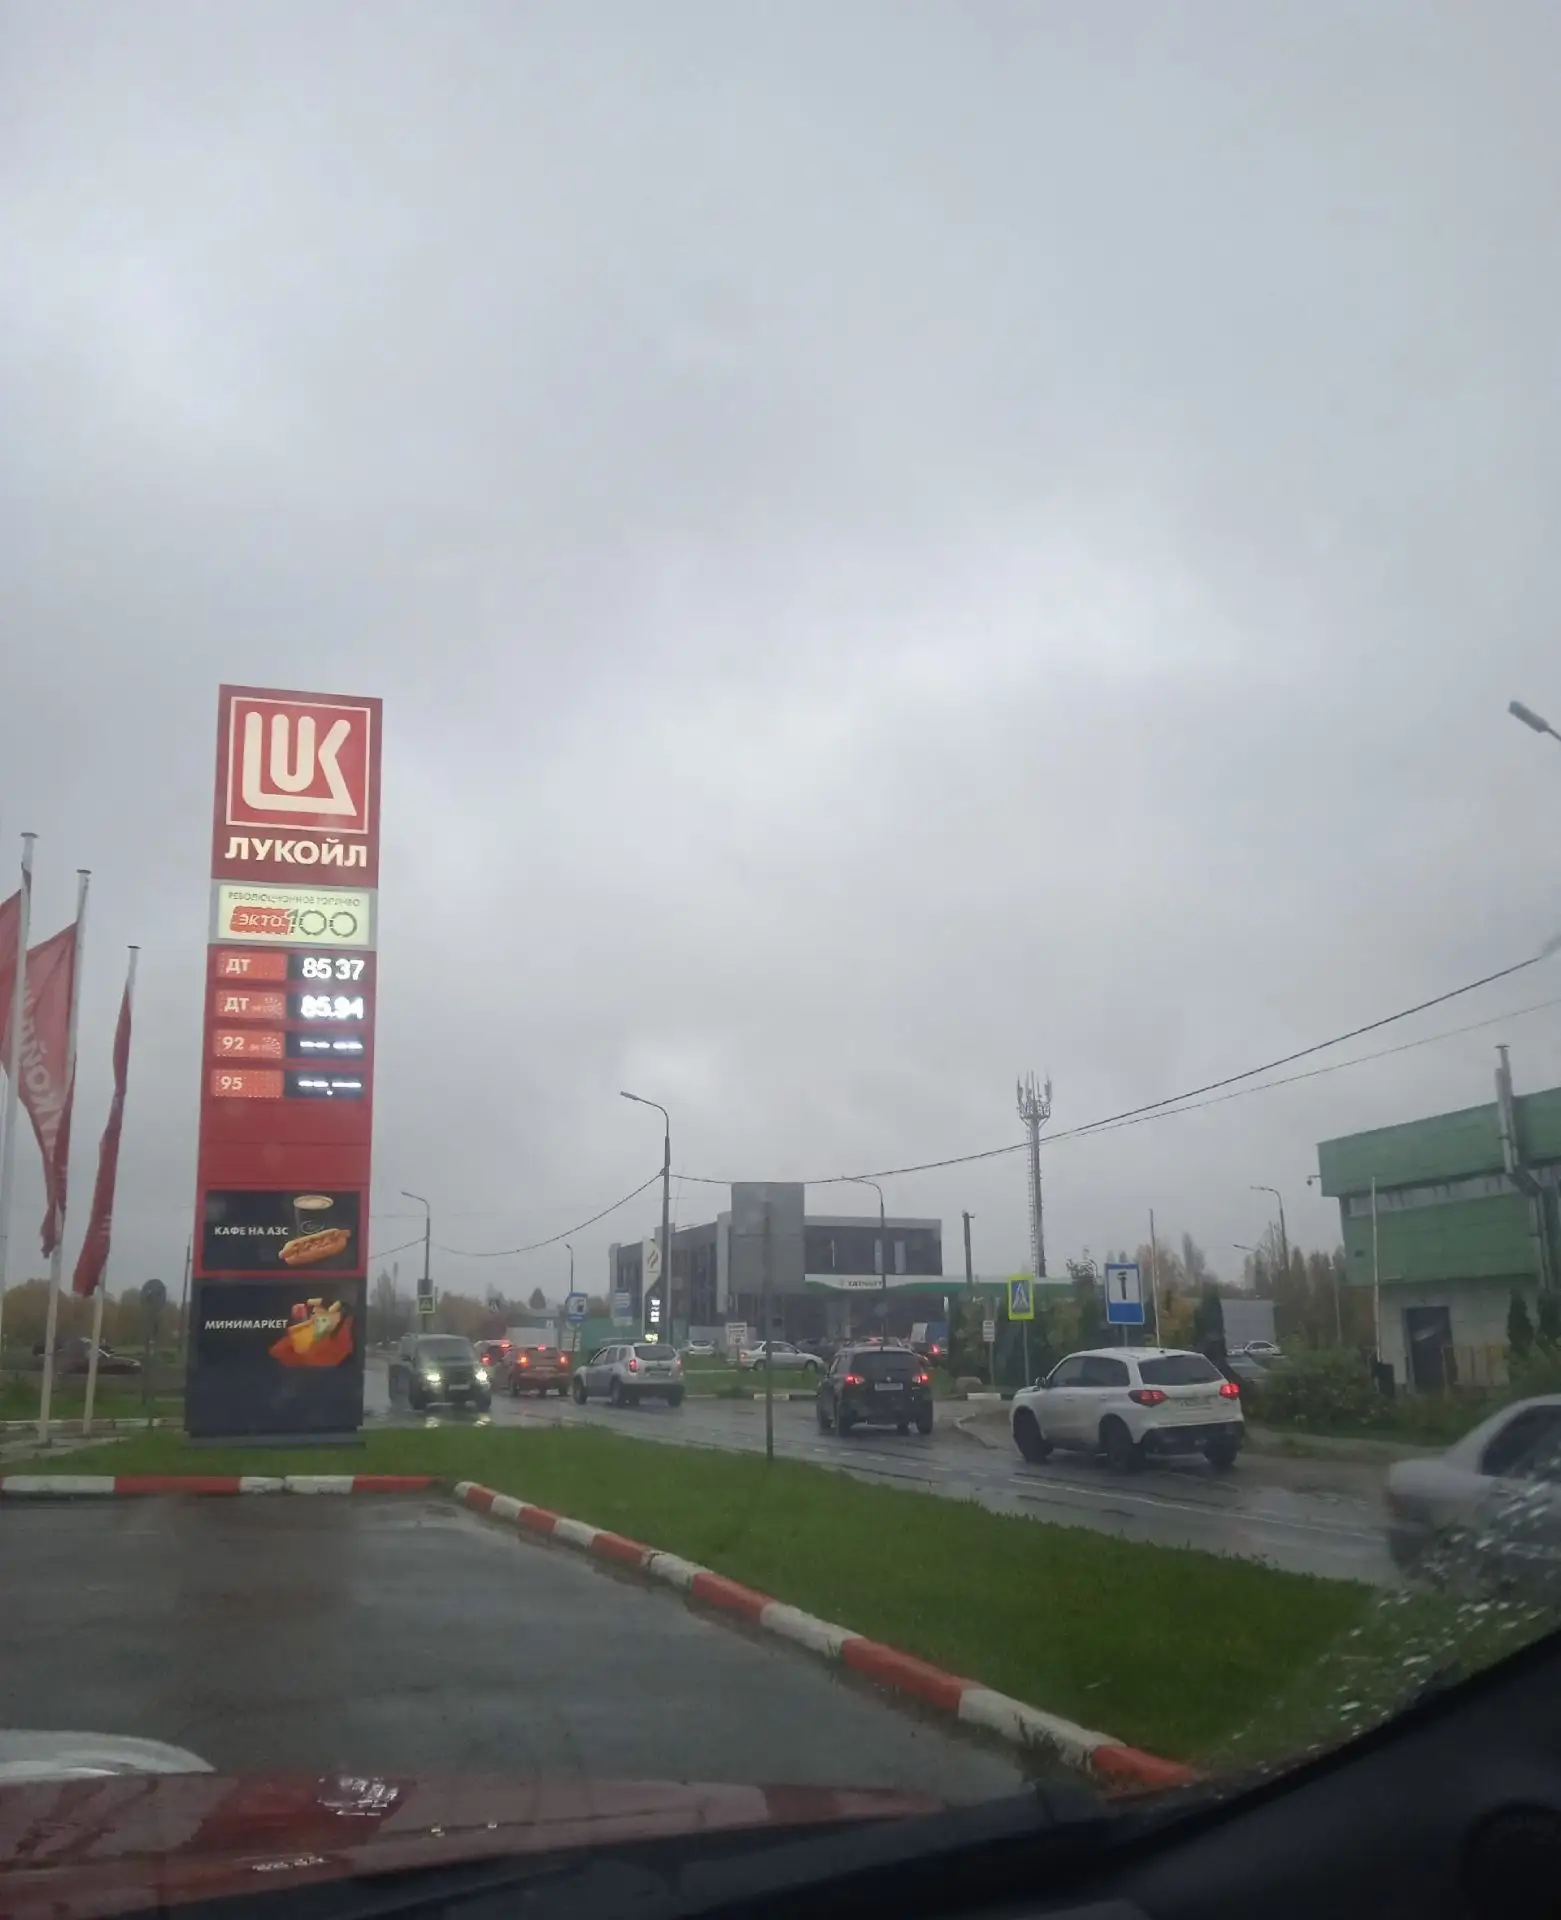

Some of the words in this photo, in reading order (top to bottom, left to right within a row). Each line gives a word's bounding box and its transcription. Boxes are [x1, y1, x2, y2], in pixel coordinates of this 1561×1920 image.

[225, 837, 367, 867] ЛУКОЙЛ
[225, 958, 251, 974] ДТ
[224, 997, 250, 1012] ДТ
[222, 1036, 245, 1051] 92
[220, 1076, 243, 1090] 95
[214, 1226, 246, 1235] КАФЕ
[248, 1226, 265, 1235] НА
[266, 1226, 289, 1235] АЗС
[204, 1319, 288, 1330] МИНИМАРКЕТ
